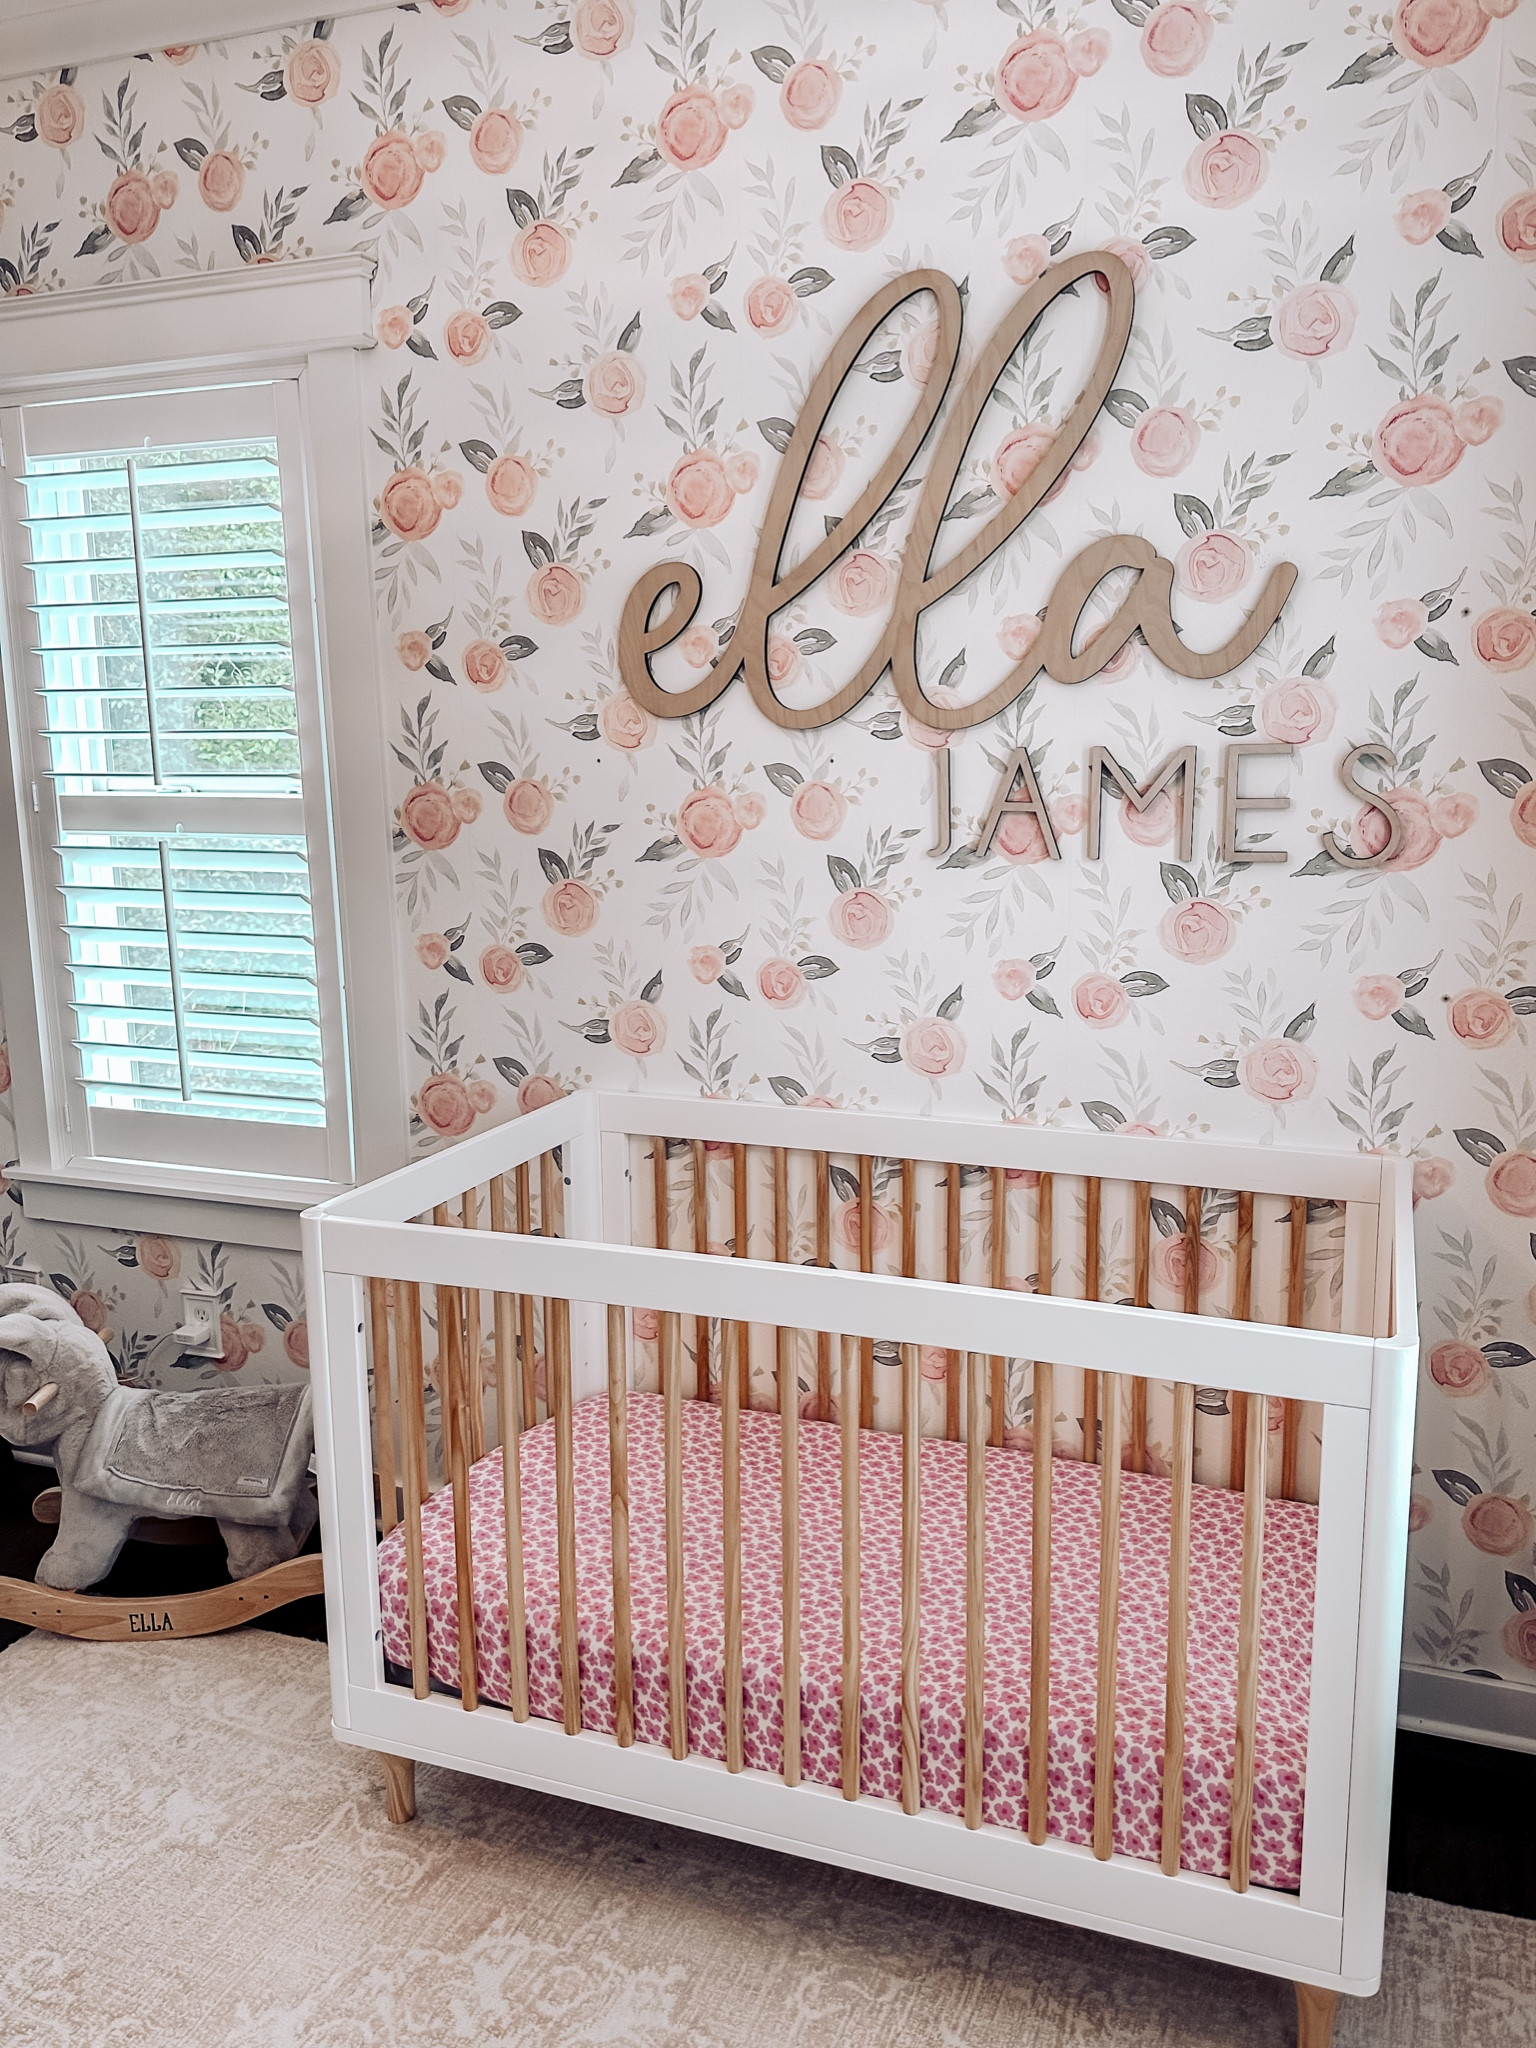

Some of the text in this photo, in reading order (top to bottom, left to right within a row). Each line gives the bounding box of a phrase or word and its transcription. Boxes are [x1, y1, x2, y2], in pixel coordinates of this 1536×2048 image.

[619, 250, 1299, 730] ella
[927, 743, 1400, 869] JAMES
[128, 1612, 174, 1632] ELLA
